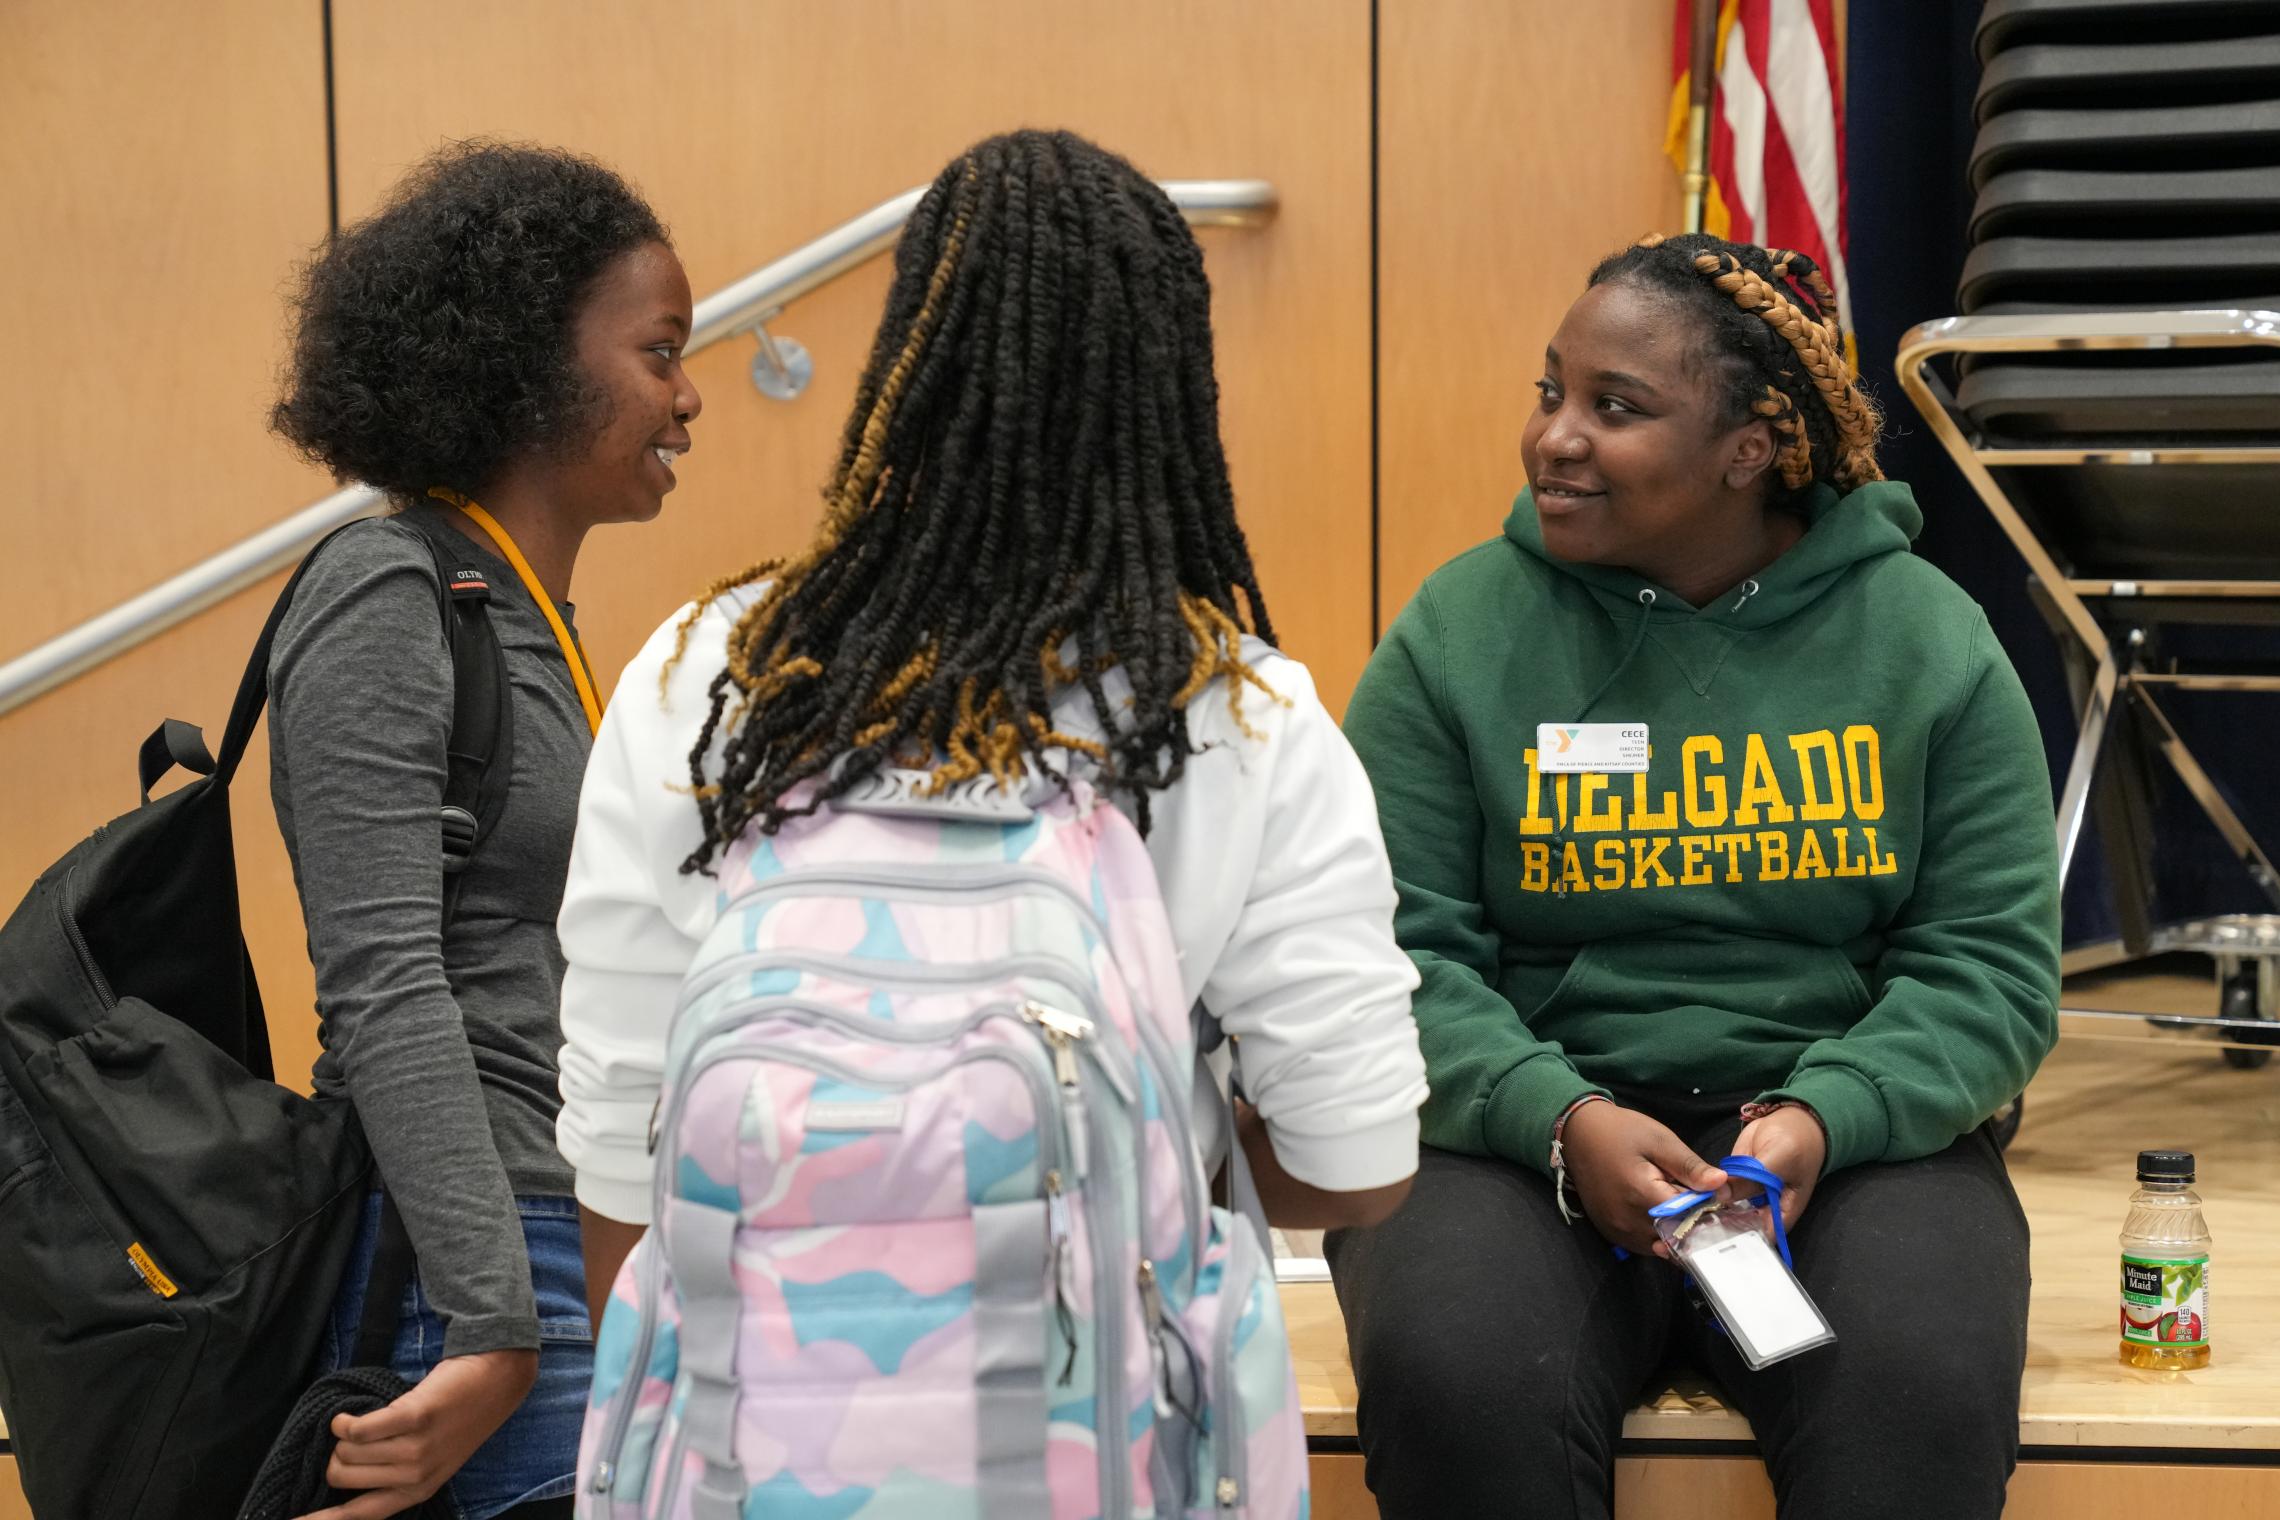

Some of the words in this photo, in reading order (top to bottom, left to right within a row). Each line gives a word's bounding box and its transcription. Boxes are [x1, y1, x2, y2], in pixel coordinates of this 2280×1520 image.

[1621, 730, 1645, 738] CECE
[1519, 724, 1886, 835] DELGADO
[1519, 826, 1898, 893] BASKETBALL
[2126, 1266, 2157, 1281] Minute
[2129, 1277, 2152, 1291] Maid
[2180, 1308, 2190, 1316] 140
